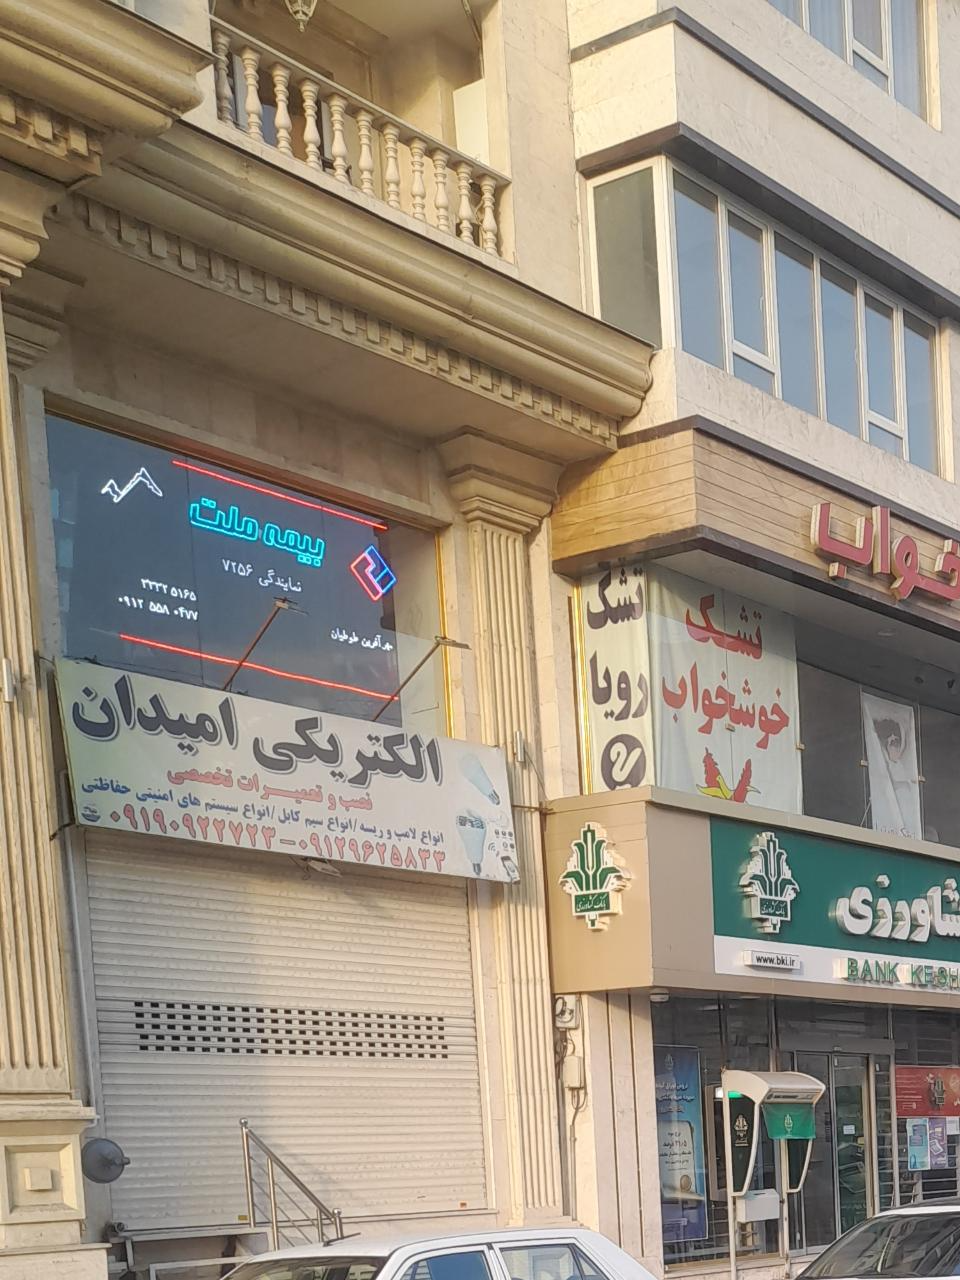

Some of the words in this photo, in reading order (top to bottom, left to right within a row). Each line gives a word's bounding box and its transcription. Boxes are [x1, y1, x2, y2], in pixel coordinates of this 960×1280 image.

[189, 498, 258, 541] ملت
[262, 523, 326, 567] بیمه
[221, 558, 254, 577] ۷۲۵۶
[258, 569, 302, 592] نمایندگی
[586, 561, 644, 629] تشک
[149, 601, 170, 615] ۵۵۸
[330, 627, 359, 643] طوطیان
[686, 593, 763, 660] تشک
[589, 650, 649, 721] رویا
[72, 675, 236, 754] امیدان
[662, 661, 790, 749] خوشخواب
[252, 716, 441, 788] الکتریکی
[81, 777, 131, 794] حفاظتی
[167, 766, 233, 787] تخصصی
[136, 786, 173, 803] امنیتی
[177, 792, 200, 808] های
[328, 793, 336, 811] و
[339, 792, 373, 811] نصب
[278, 809, 300, 824] کابل
[305, 816, 324, 828] سیم
[420, 829, 444, 846] انواع
[756, 954, 795, 967] www.bki.ir
[846, 956, 899, 983] BANK
